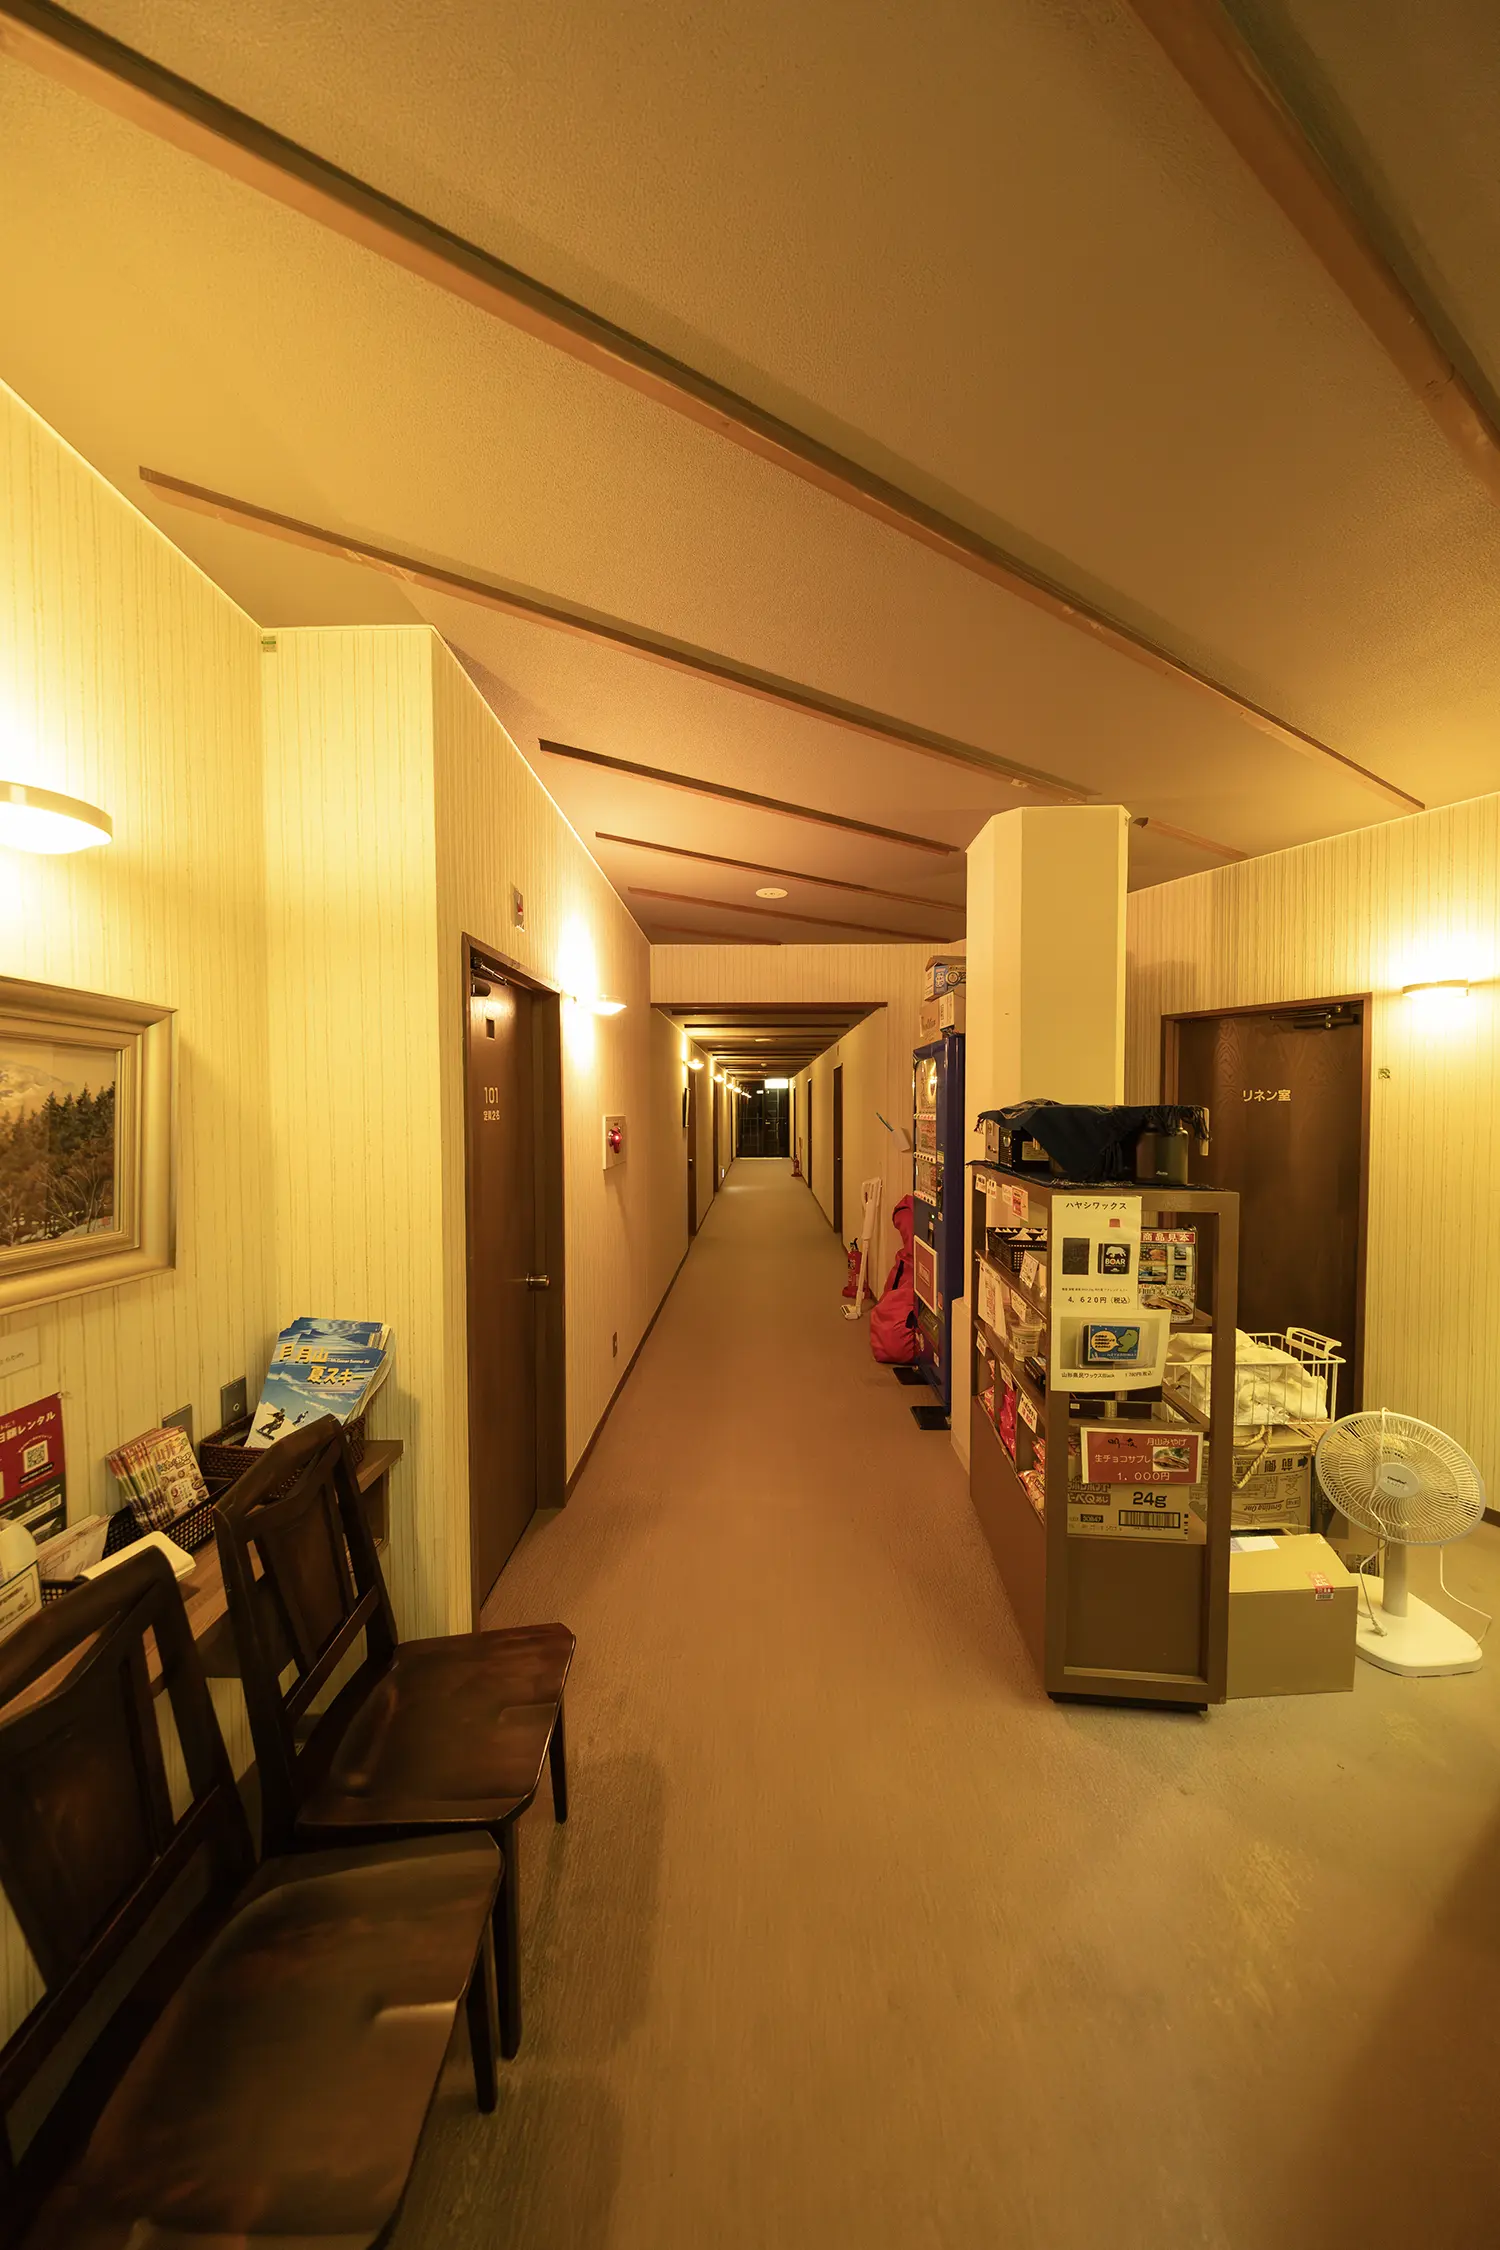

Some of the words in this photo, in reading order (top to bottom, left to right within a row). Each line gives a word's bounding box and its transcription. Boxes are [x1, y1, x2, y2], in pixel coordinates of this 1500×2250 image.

[484, 1086, 499, 1104] 101
[1243, 1089, 1292, 1102] リネン室
[1065, 1201, 1127, 1210] ハヤシワックス
[1142, 1232, 1190, 1242] 商品見本
[295, 1345, 329, 1364] 月山
[307, 1365, 365, 1385] 夏スキー
[1146, 1437, 1187, 1446] 月山みやげ
[1094, 1454, 1152, 1464] 生チョコサブレ
[1132, 1491, 1167, 1508] 24g
